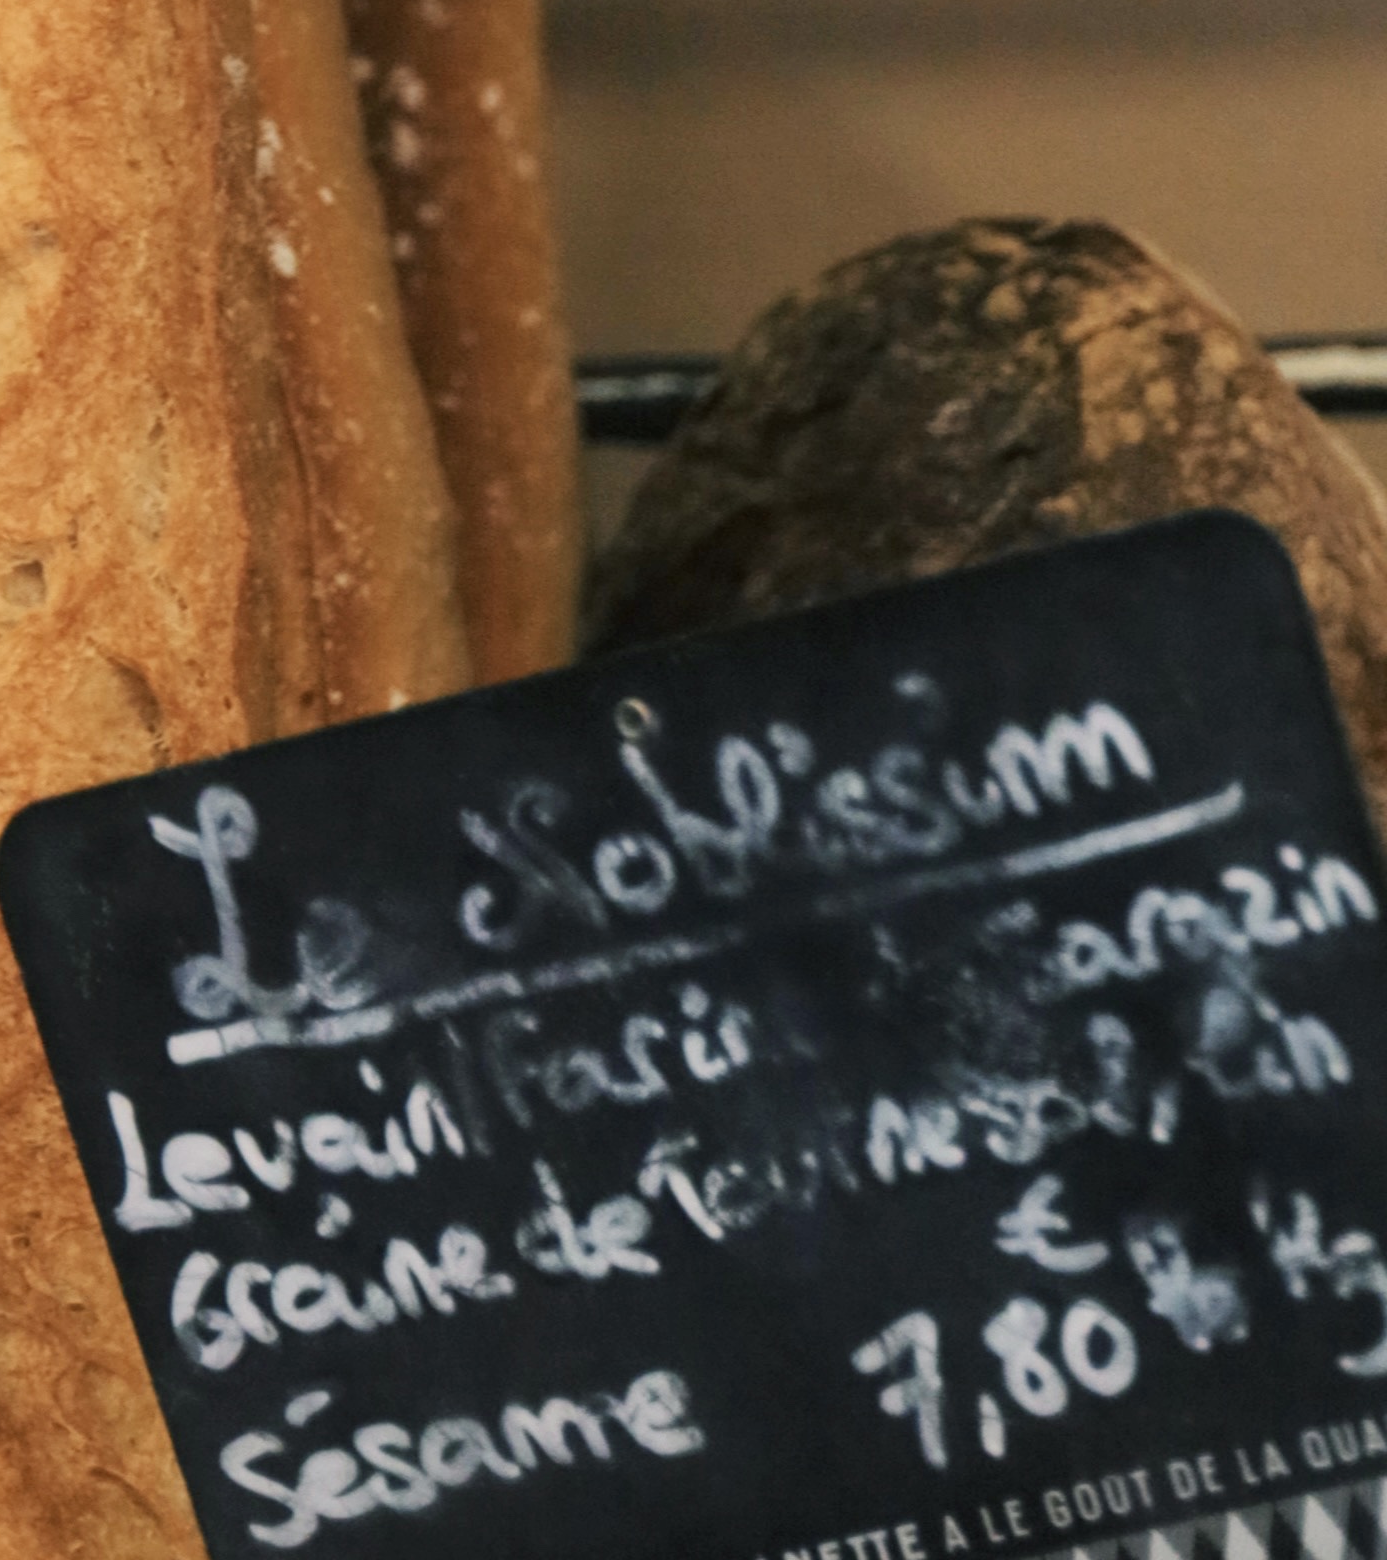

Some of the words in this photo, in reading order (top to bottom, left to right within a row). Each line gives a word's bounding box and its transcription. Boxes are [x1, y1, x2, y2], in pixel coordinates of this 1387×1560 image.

[151, 784, 381, 1022] Le
[107, 1058, 467, 1232] Levain
[516, 1156, 661, 1280] de
[993, 1172, 1110, 1274] €
[219, 1370, 707, 1549] Sésame
[850, 1295, 1139, 1470] 7,80
[942, 1512, 970, 1554] A
[978, 1497, 1031, 1544] LE
[1042, 1468, 1157, 1530] GOUT
[1166, 1452, 1225, 1501] DE
[1233, 1440, 1293, 1487] LA
